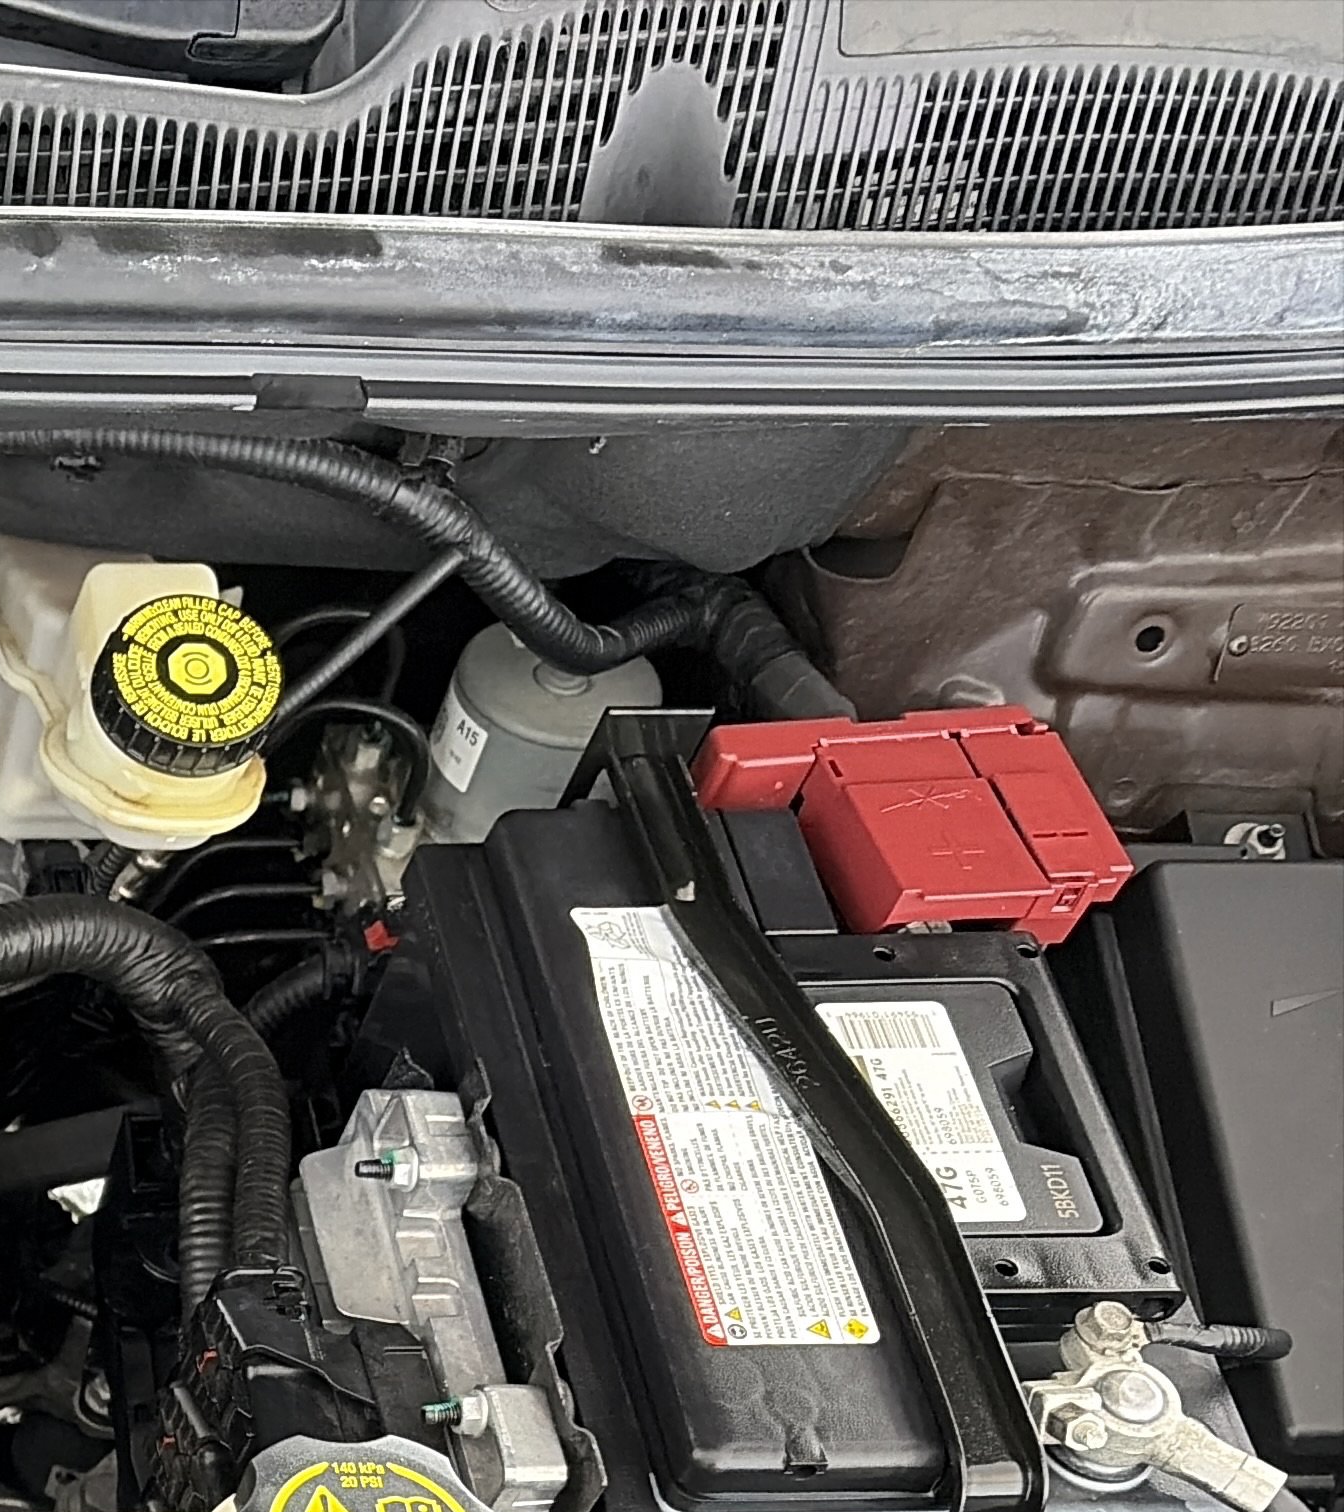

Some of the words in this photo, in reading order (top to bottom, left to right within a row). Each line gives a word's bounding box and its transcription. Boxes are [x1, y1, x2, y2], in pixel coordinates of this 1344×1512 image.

[456, 719, 479, 746] A15
[869, 1058, 888, 1080] 47G
[641, 1120, 679, 1209] PELIGRO/VENENO
[933, 1166, 969, 1209] 47G
[1040, 1164, 1079, 1218] 5BKD11
[677, 1232, 716, 1323] DANGER/POISON
[330, 1461, 357, 1475] 140
[358, 1462, 386, 1476] kPa
[339, 1476, 358, 1489] 20
[359, 1477, 384, 1489] PSI
